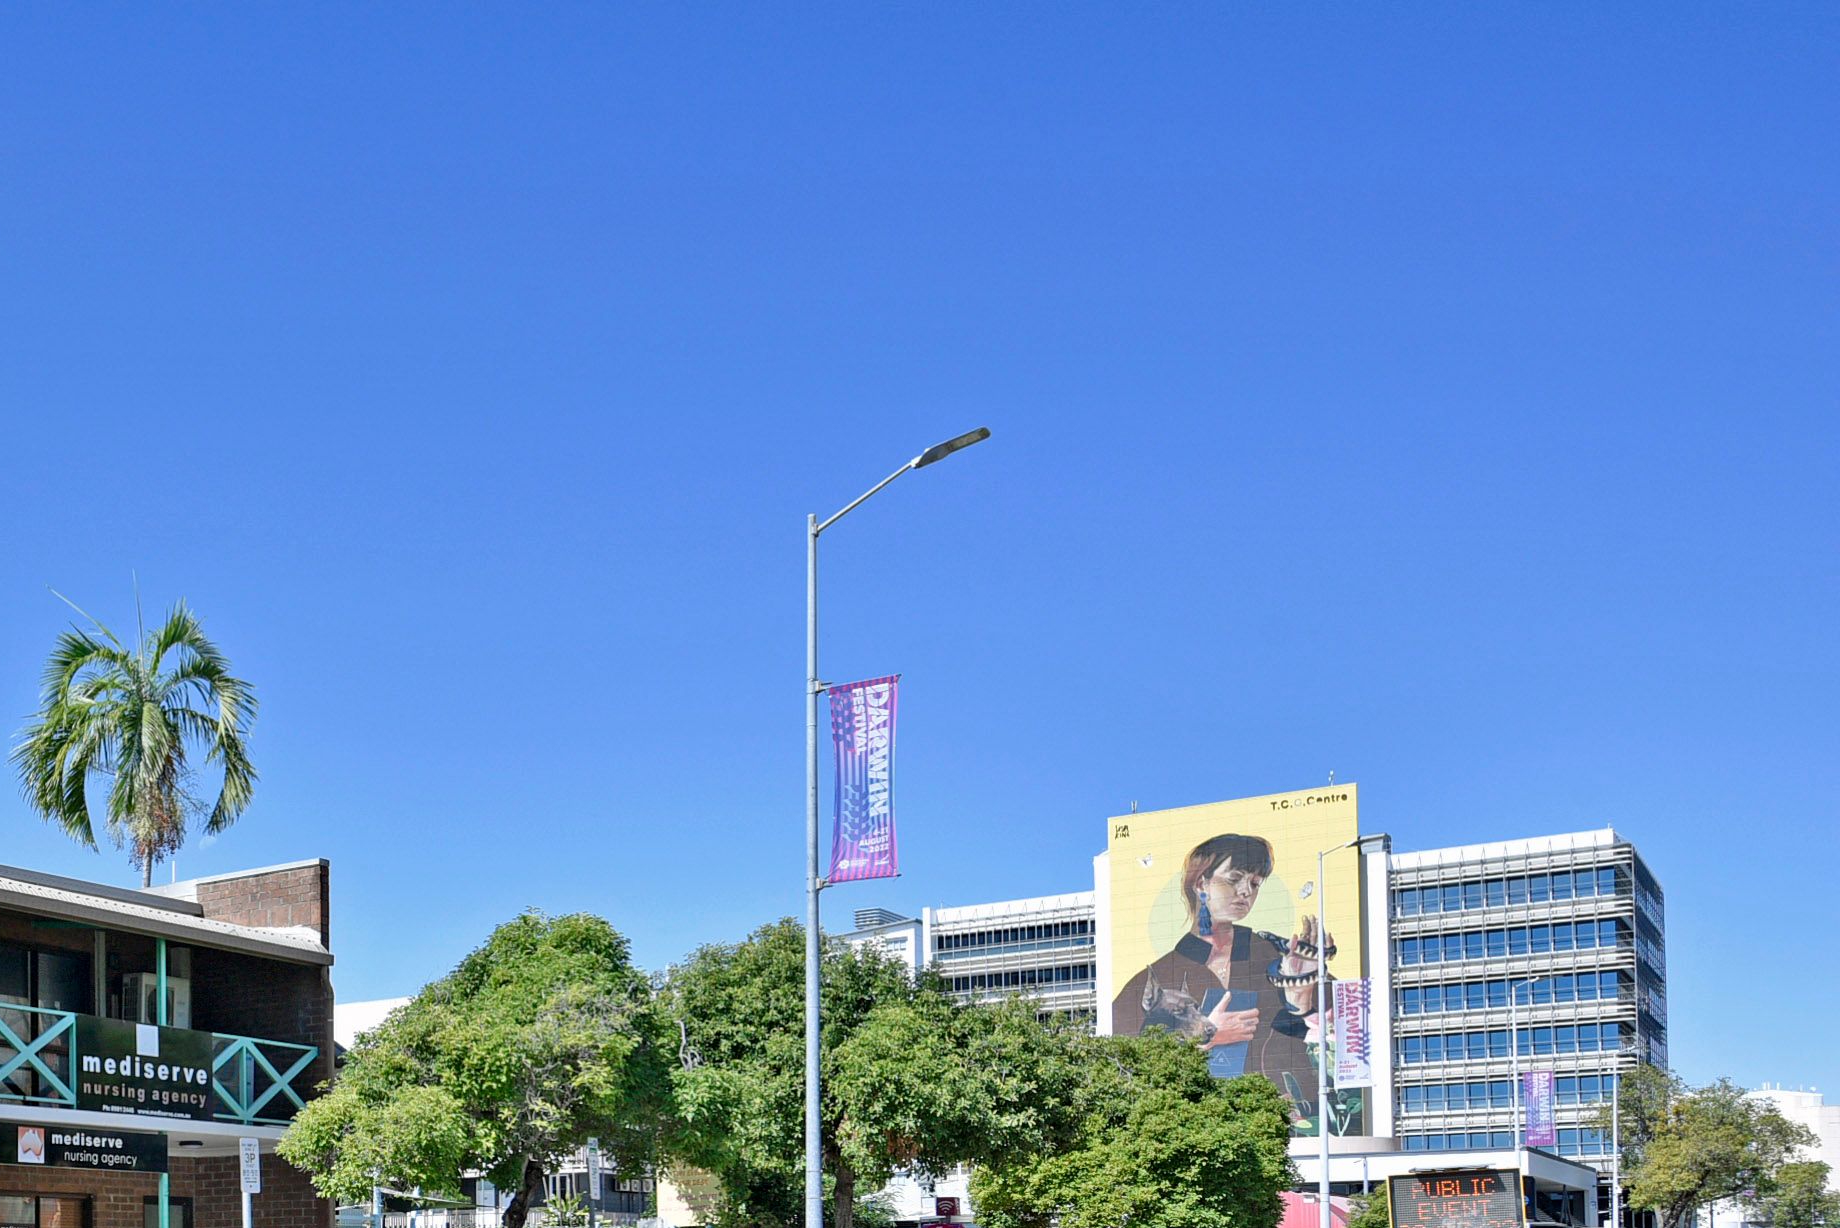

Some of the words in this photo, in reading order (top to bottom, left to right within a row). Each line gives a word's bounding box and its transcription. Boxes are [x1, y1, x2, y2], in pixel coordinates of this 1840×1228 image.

[852, 687, 868, 756] FESTIVAL
[865, 682, 890, 817] DARWIN
[1345, 982, 1360, 1053] DARWIN
[82, 1055, 208, 1085] mediserve
[83, 1082, 146, 1102] nursing
[152, 1089, 207, 1108] agency
[51, 1132, 123, 1149] mediserve
[64, 1150, 99, 1164] nursing
[101, 1153, 137, 1167] agency
[1411, 1178, 1495, 1200] PUBLIC
[1417, 1199, 1492, 1220] EVENT
